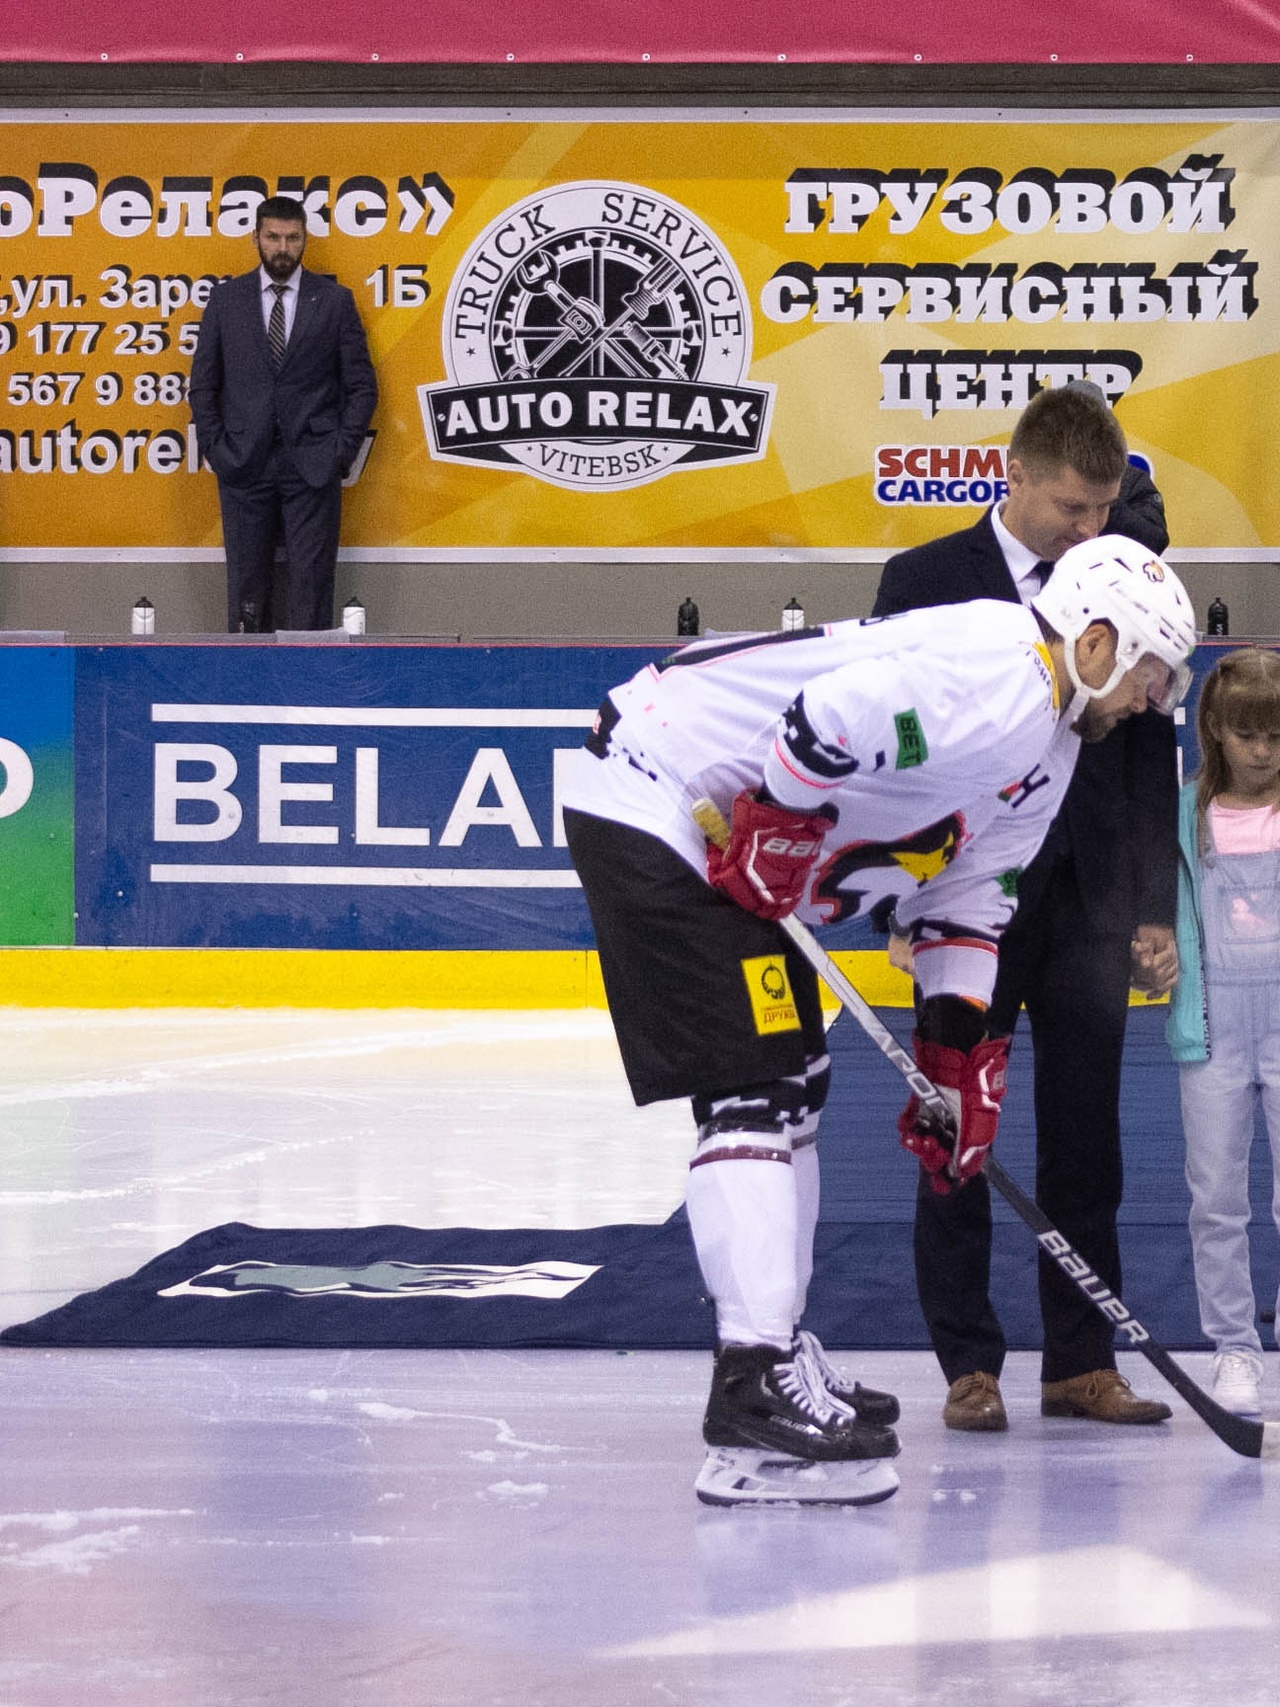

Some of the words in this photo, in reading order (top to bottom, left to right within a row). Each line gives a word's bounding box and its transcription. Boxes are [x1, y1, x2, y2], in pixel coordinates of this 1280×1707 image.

[784, 153, 1236, 234] ГРУЗОВОЙ
[100, 264, 230, 318] Заре
[366, 264, 432, 308] 1Б
[455, 204, 556, 340] TRUCK
[601, 192, 744, 339] SERVICE
[761, 249, 1258, 323] СЕРВИСНЫЙ
[28, 321, 106, 356] 177
[114, 321, 170, 356] 25
[8, 372, 85, 406] 567
[95, 372, 123, 406] 9
[134, 372, 192, 406] 88
[880, 350, 1143, 419] ЦЕНТР
[446, 391, 573, 437] AUTO
[588, 390, 754, 438] RELAX
[538, 443, 661, 477] VITEBSK
[878, 448, 1010, 478] SCHM
[153, 743, 584, 848] BELA
